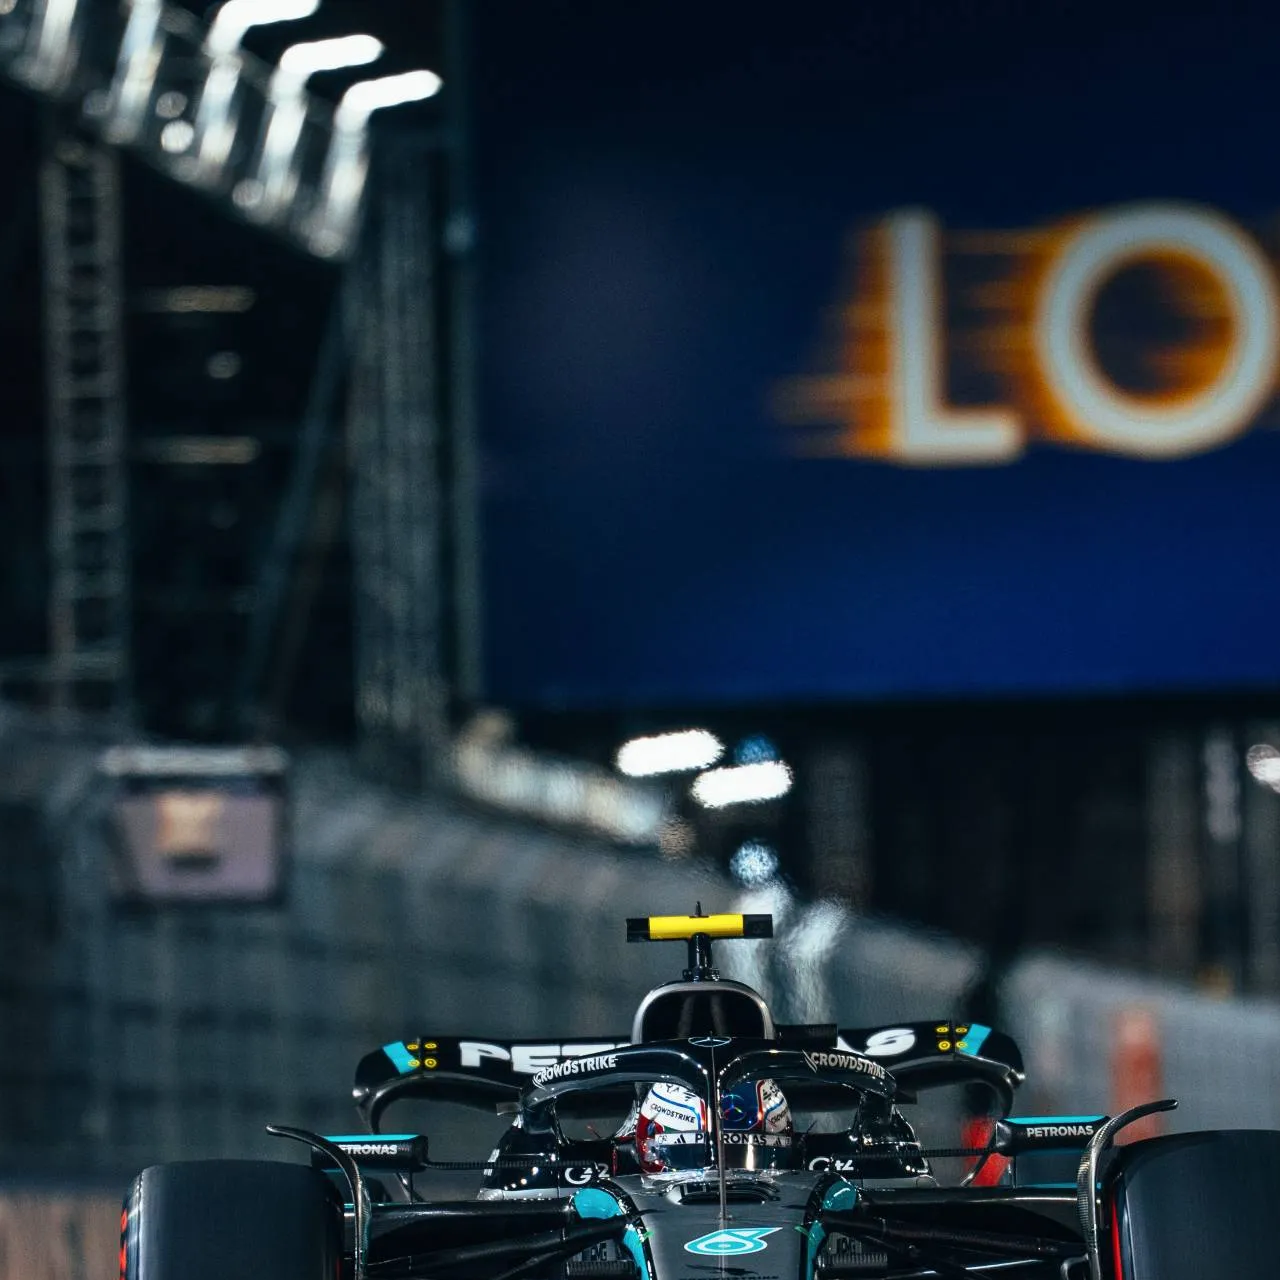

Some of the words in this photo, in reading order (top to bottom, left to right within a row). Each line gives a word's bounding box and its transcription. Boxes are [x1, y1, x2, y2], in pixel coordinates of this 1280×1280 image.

[534, 1053, 619, 1085] CROWDSTRIKE
[810, 1051, 886, 1081] CROWDSTRIKE
[650, 1102, 697, 1125] CROWDSTRIKE
[1026, 1125, 1095, 1138] PETRONAS
